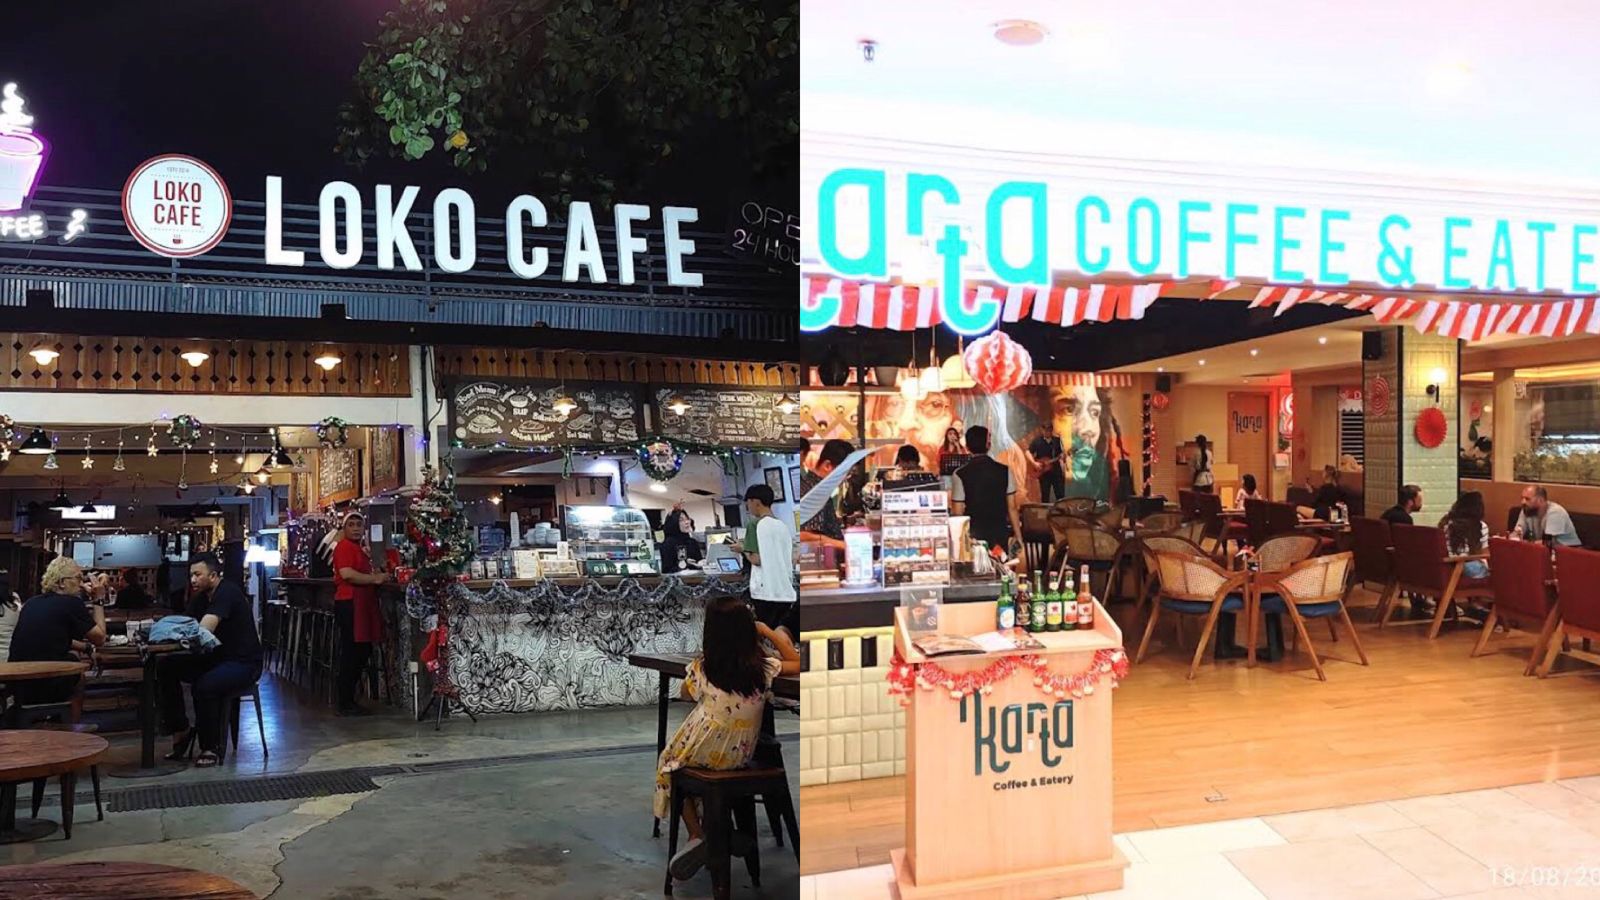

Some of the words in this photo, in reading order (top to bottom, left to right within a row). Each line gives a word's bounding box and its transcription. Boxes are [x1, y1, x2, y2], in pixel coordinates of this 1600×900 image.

[153, 180, 202, 203] LOKO
[153, 203, 202, 227] CAFE
[265, 175, 477, 274] LOKO
[506, 194, 703, 287] CAFE
[800, 168, 1048, 330] arta
[1076, 195, 1351, 284] COFFEE
[1377, 213, 1416, 286] &
[1444, 216, 1598, 292] EATE
[993, 779, 1028, 791] Coffee
[1030, 778, 1038, 787] &
[1039, 775, 1074, 787] Eatery
